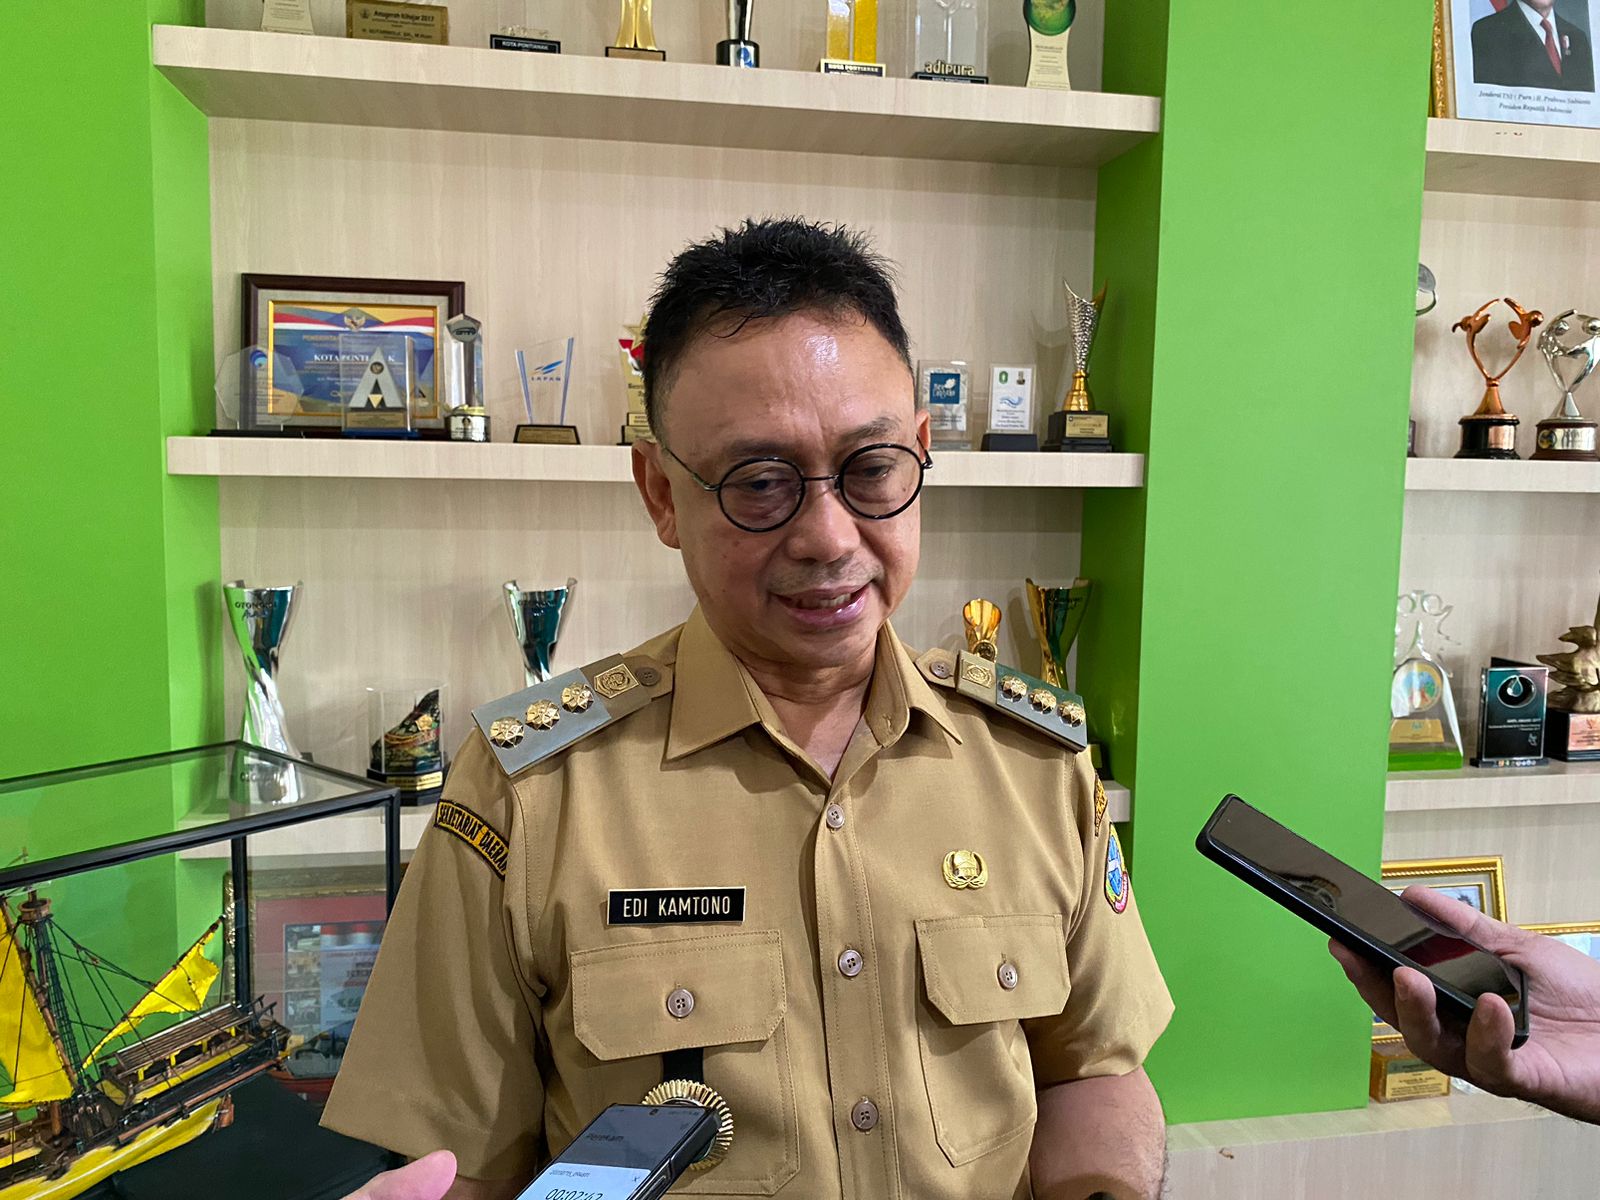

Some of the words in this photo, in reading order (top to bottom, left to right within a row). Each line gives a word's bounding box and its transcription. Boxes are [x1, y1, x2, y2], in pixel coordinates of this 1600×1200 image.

[925, 60, 976, 76] adipura
[313, 353, 339, 362] KOTA
[439, 803, 484, 842] SEKRETARIAT
[623, 897, 648, 918] EDI
[658, 895, 731, 917] KAMTONO
